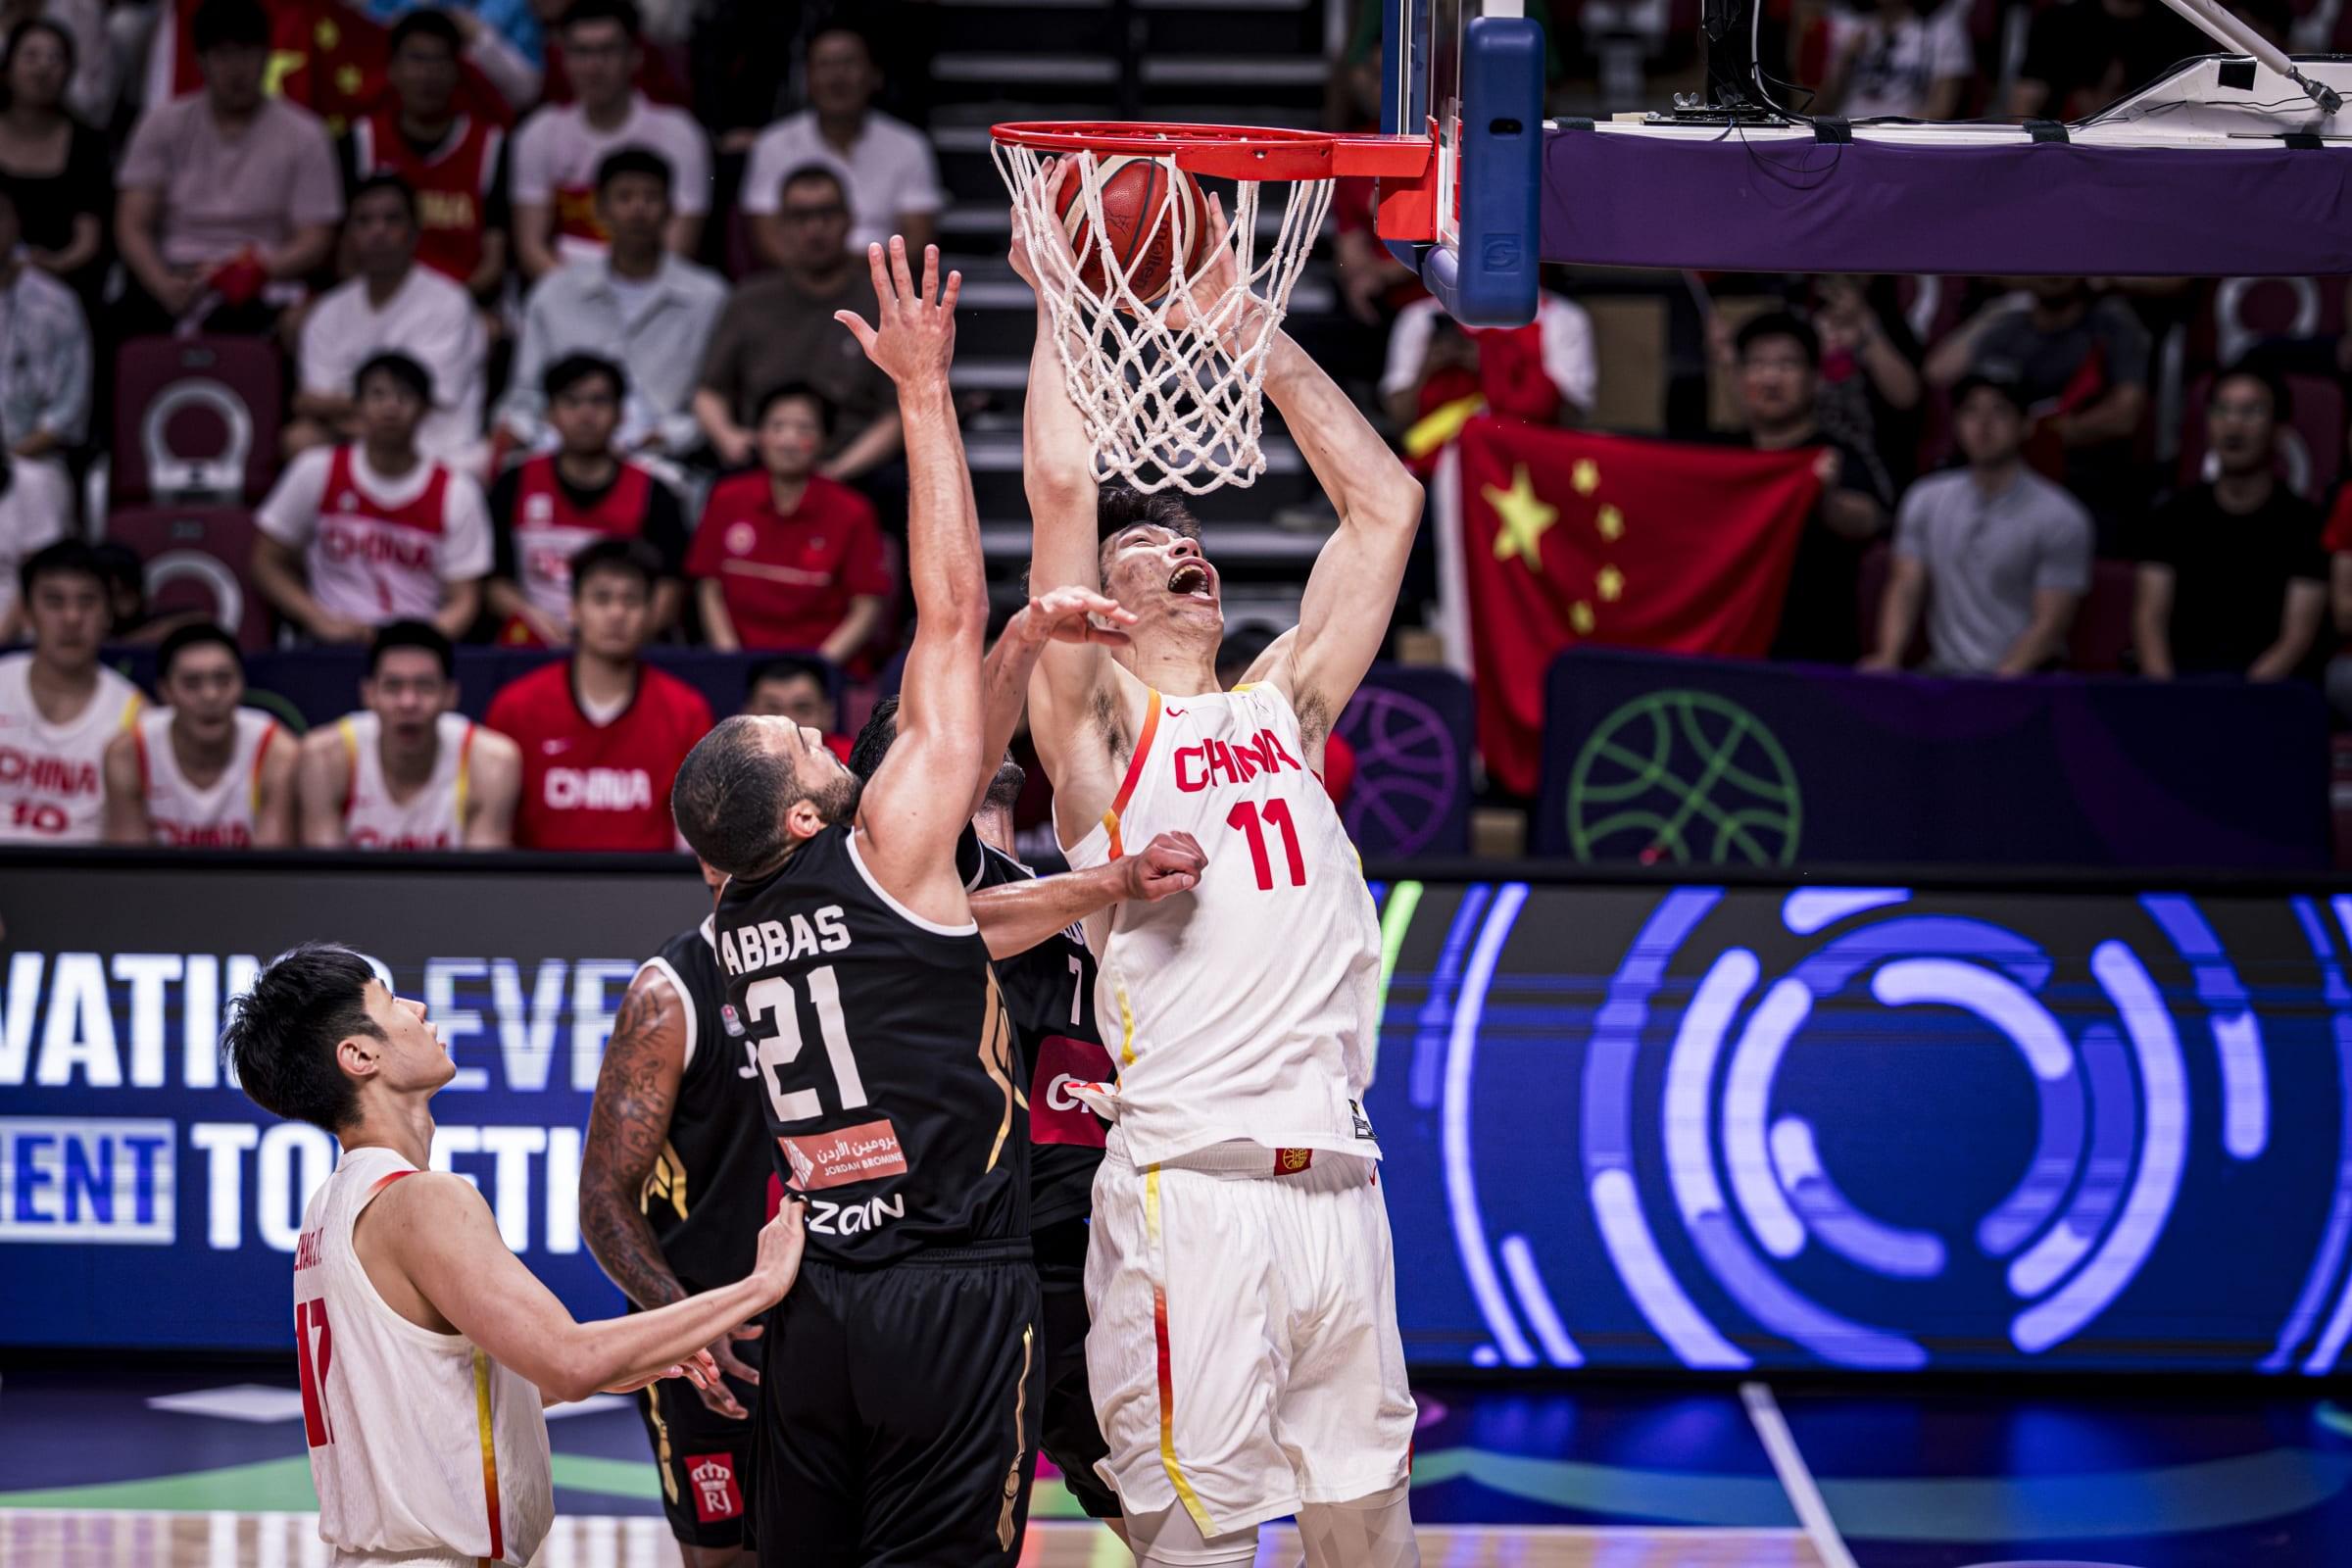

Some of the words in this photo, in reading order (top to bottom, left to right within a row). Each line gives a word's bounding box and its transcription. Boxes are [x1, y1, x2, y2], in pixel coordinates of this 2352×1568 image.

[1226, 798, 1306, 891] 11
[721, 904, 853, 976] ABBAS
[745, 964, 868, 1123] 21
[0, 1135, 167, 1224] ENT
[824, 1161, 860, 1177] JORDAN
[861, 1152, 905, 1170] BROMINE
[297, 1298, 335, 1447] 17
[705, 1488, 733, 1516] RJ
